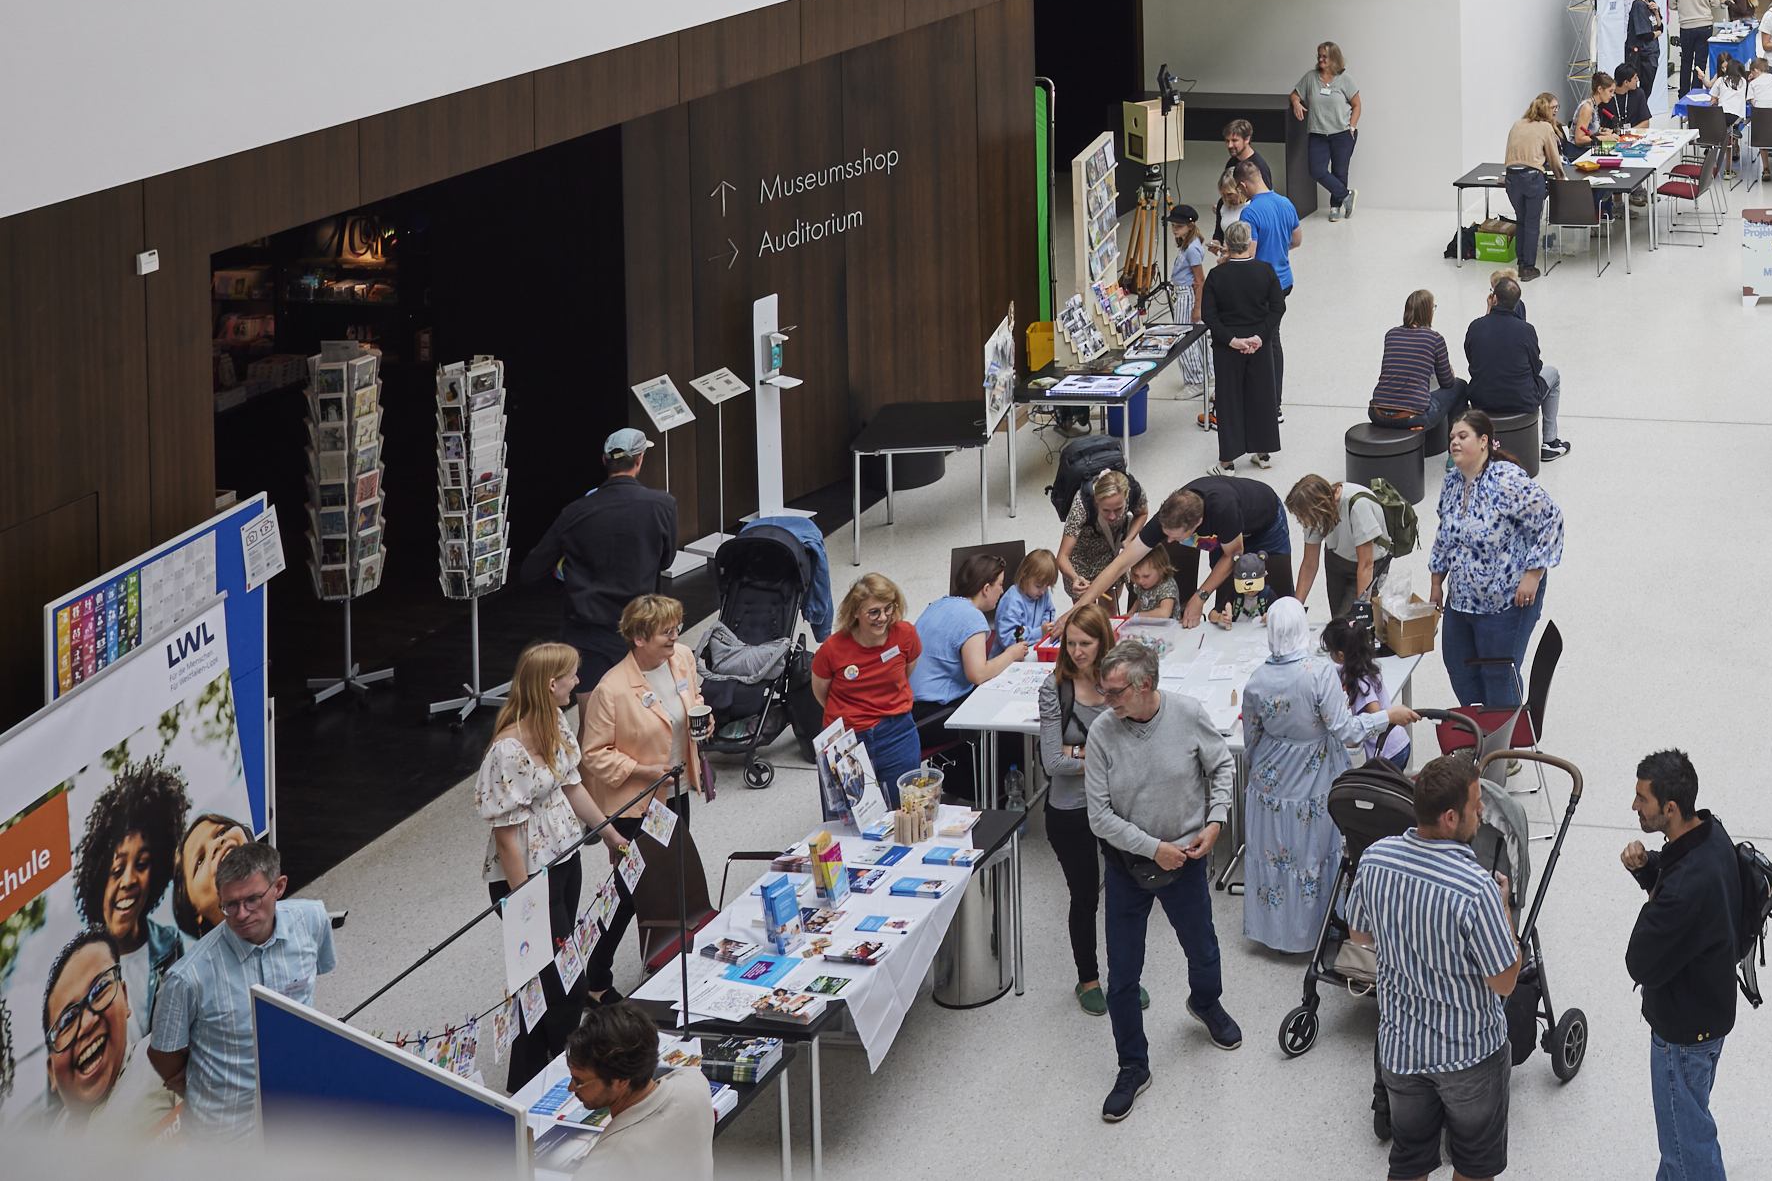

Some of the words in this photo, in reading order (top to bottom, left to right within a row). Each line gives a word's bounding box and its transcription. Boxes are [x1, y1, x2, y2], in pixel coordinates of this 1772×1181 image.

[759, 147, 899, 204] Museumsshop
[758, 210, 863, 258] Auditorium
[166, 621, 215, 669] LWL
[169, 673, 178, 682] Für
[178, 667, 186, 675] die
[170, 682, 179, 692] Für
